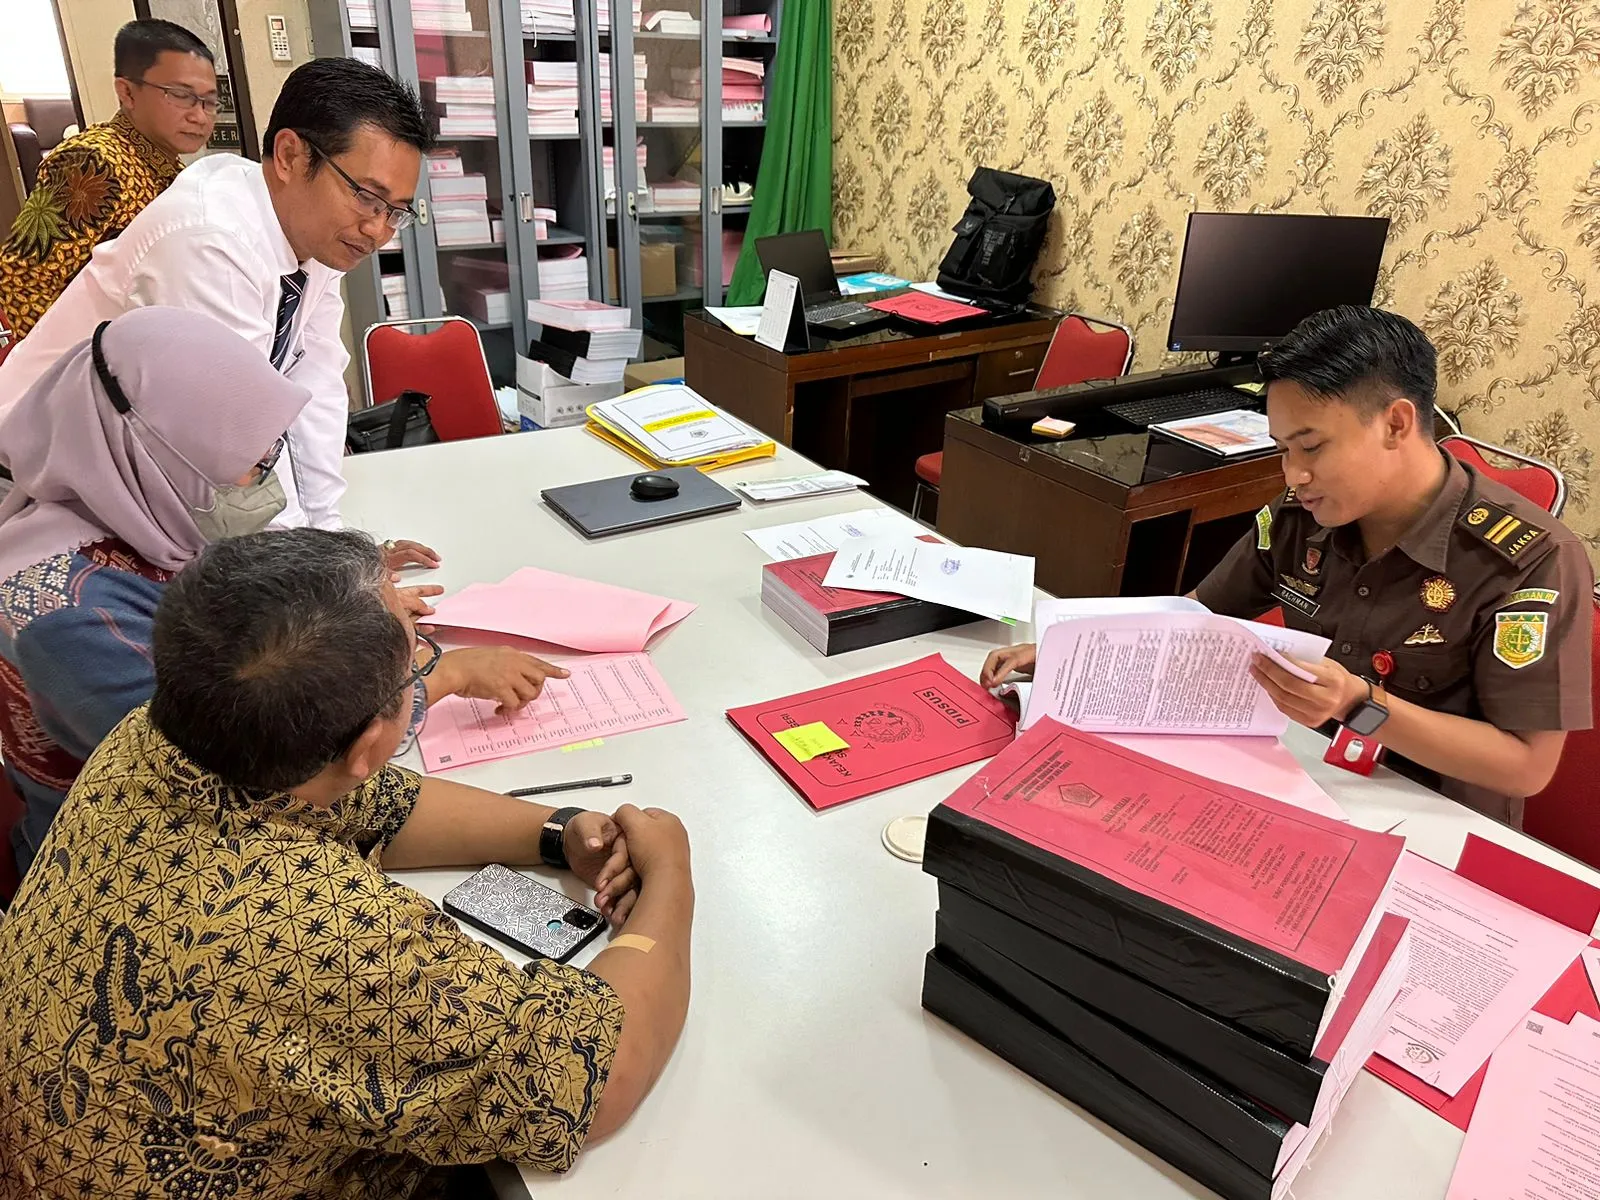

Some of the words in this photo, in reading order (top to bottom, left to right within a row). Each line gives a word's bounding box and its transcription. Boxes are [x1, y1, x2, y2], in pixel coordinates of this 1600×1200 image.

[1508, 529, 1539, 555] JAKSA
[1280, 589, 1309, 609] RACHMAN
[922, 690, 970, 724] PIDSUS
